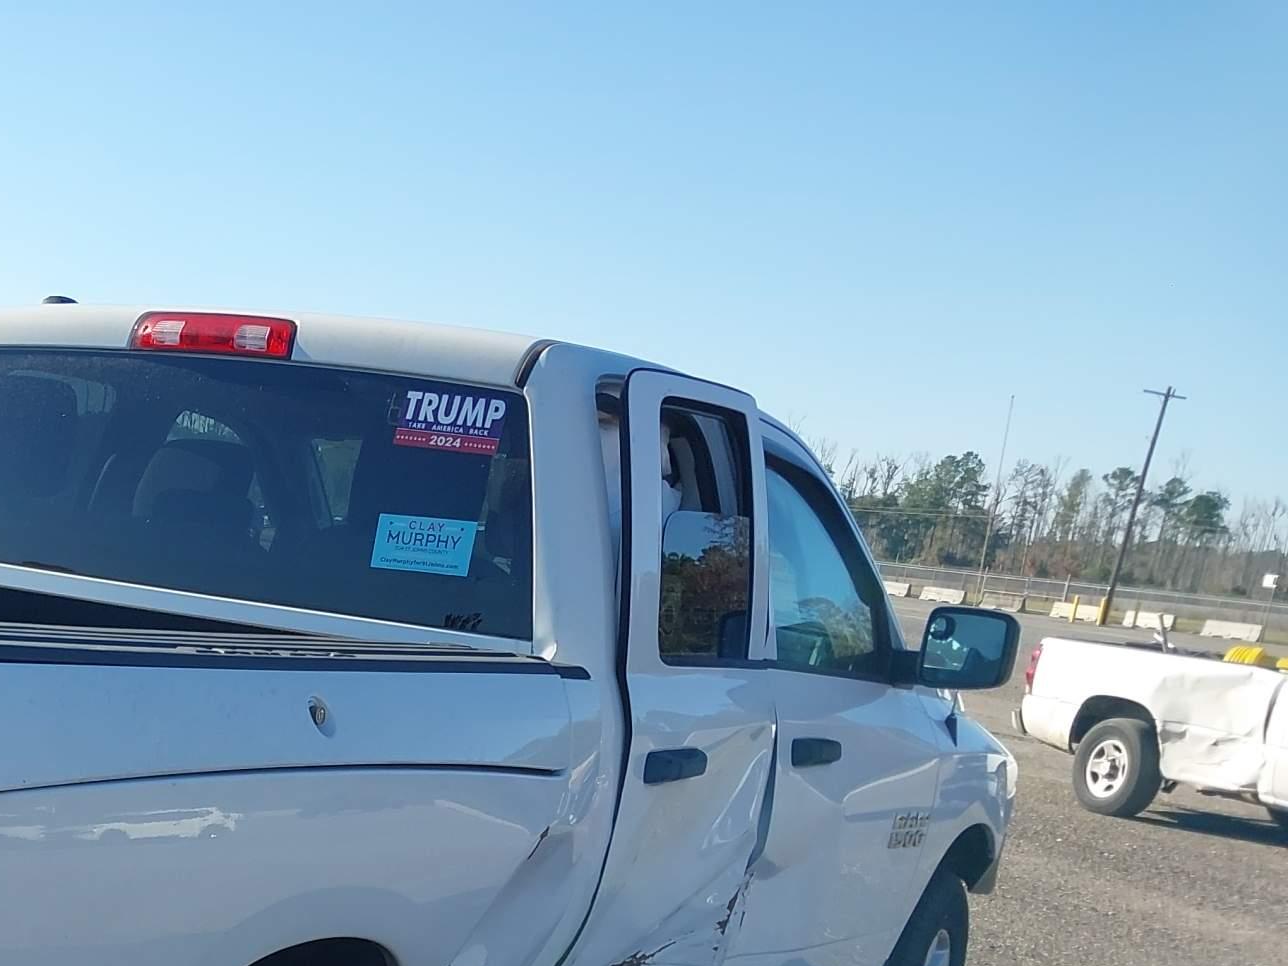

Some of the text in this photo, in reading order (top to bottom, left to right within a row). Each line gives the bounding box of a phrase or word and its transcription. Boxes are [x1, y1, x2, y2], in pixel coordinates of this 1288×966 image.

[405, 390, 506, 429] TRUMP
[431, 424, 464, 434] AMERICA
[469, 428, 489, 436] BACK
[428, 435, 461, 448] 2024
[408, 520, 445, 532] CLAY
[386, 529, 462, 550] MURPHY
